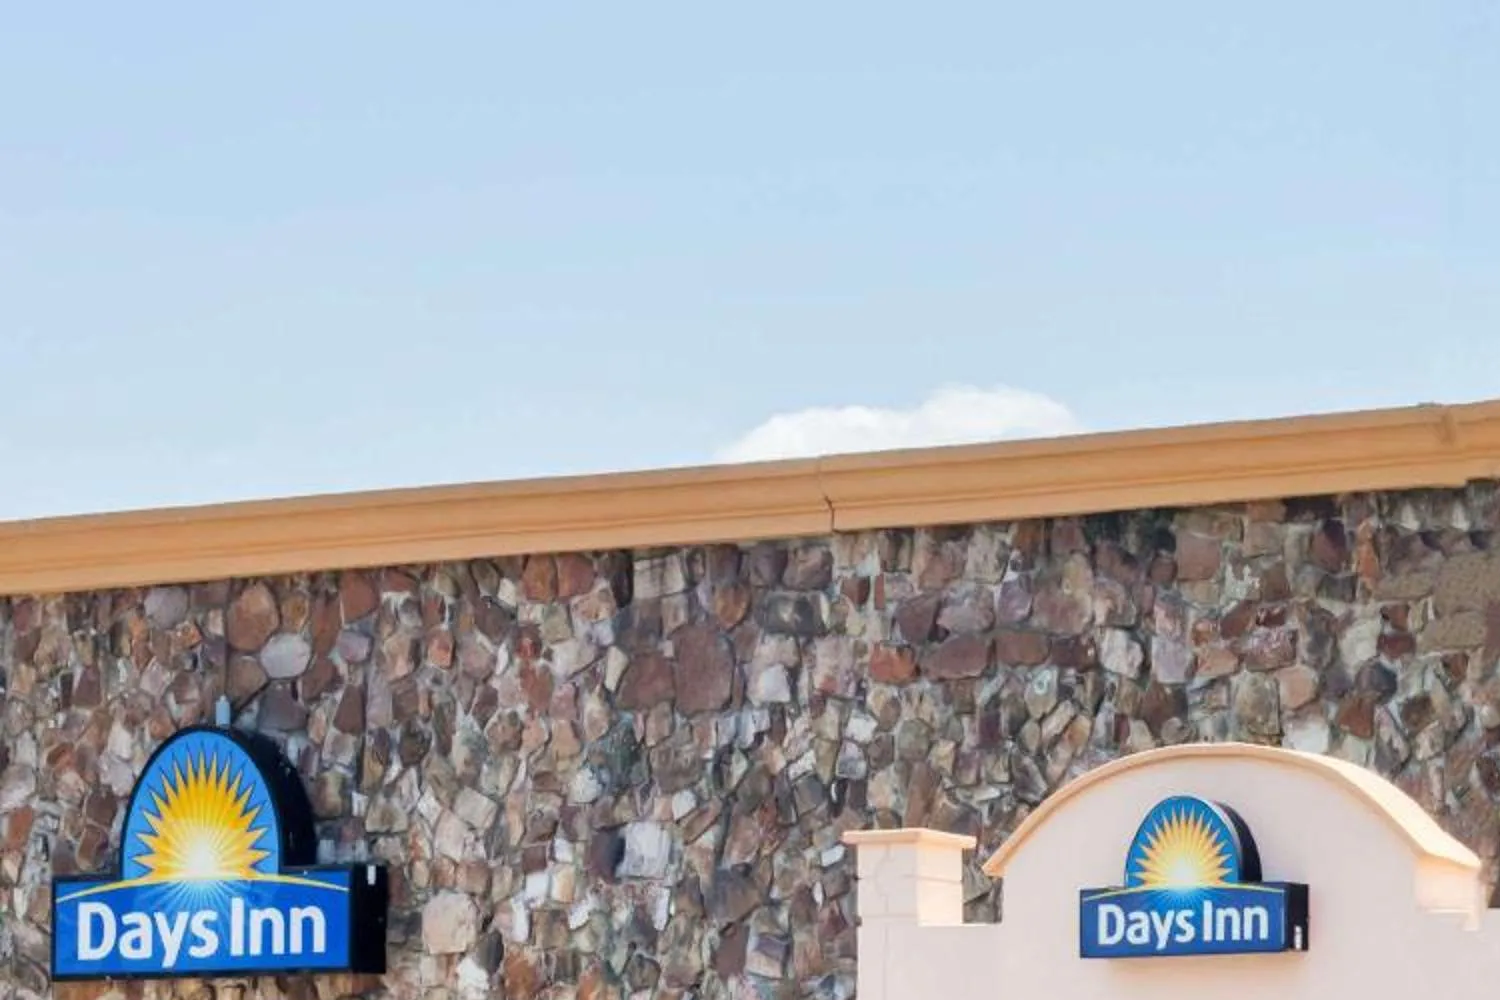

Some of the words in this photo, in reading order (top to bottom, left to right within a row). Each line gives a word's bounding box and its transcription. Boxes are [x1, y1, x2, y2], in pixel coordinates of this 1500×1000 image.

[77, 902, 219, 968] Days
[230, 897, 326, 956] Inn
[1097, 903, 1195, 950] Days
[1203, 900, 1268, 942] Inn
